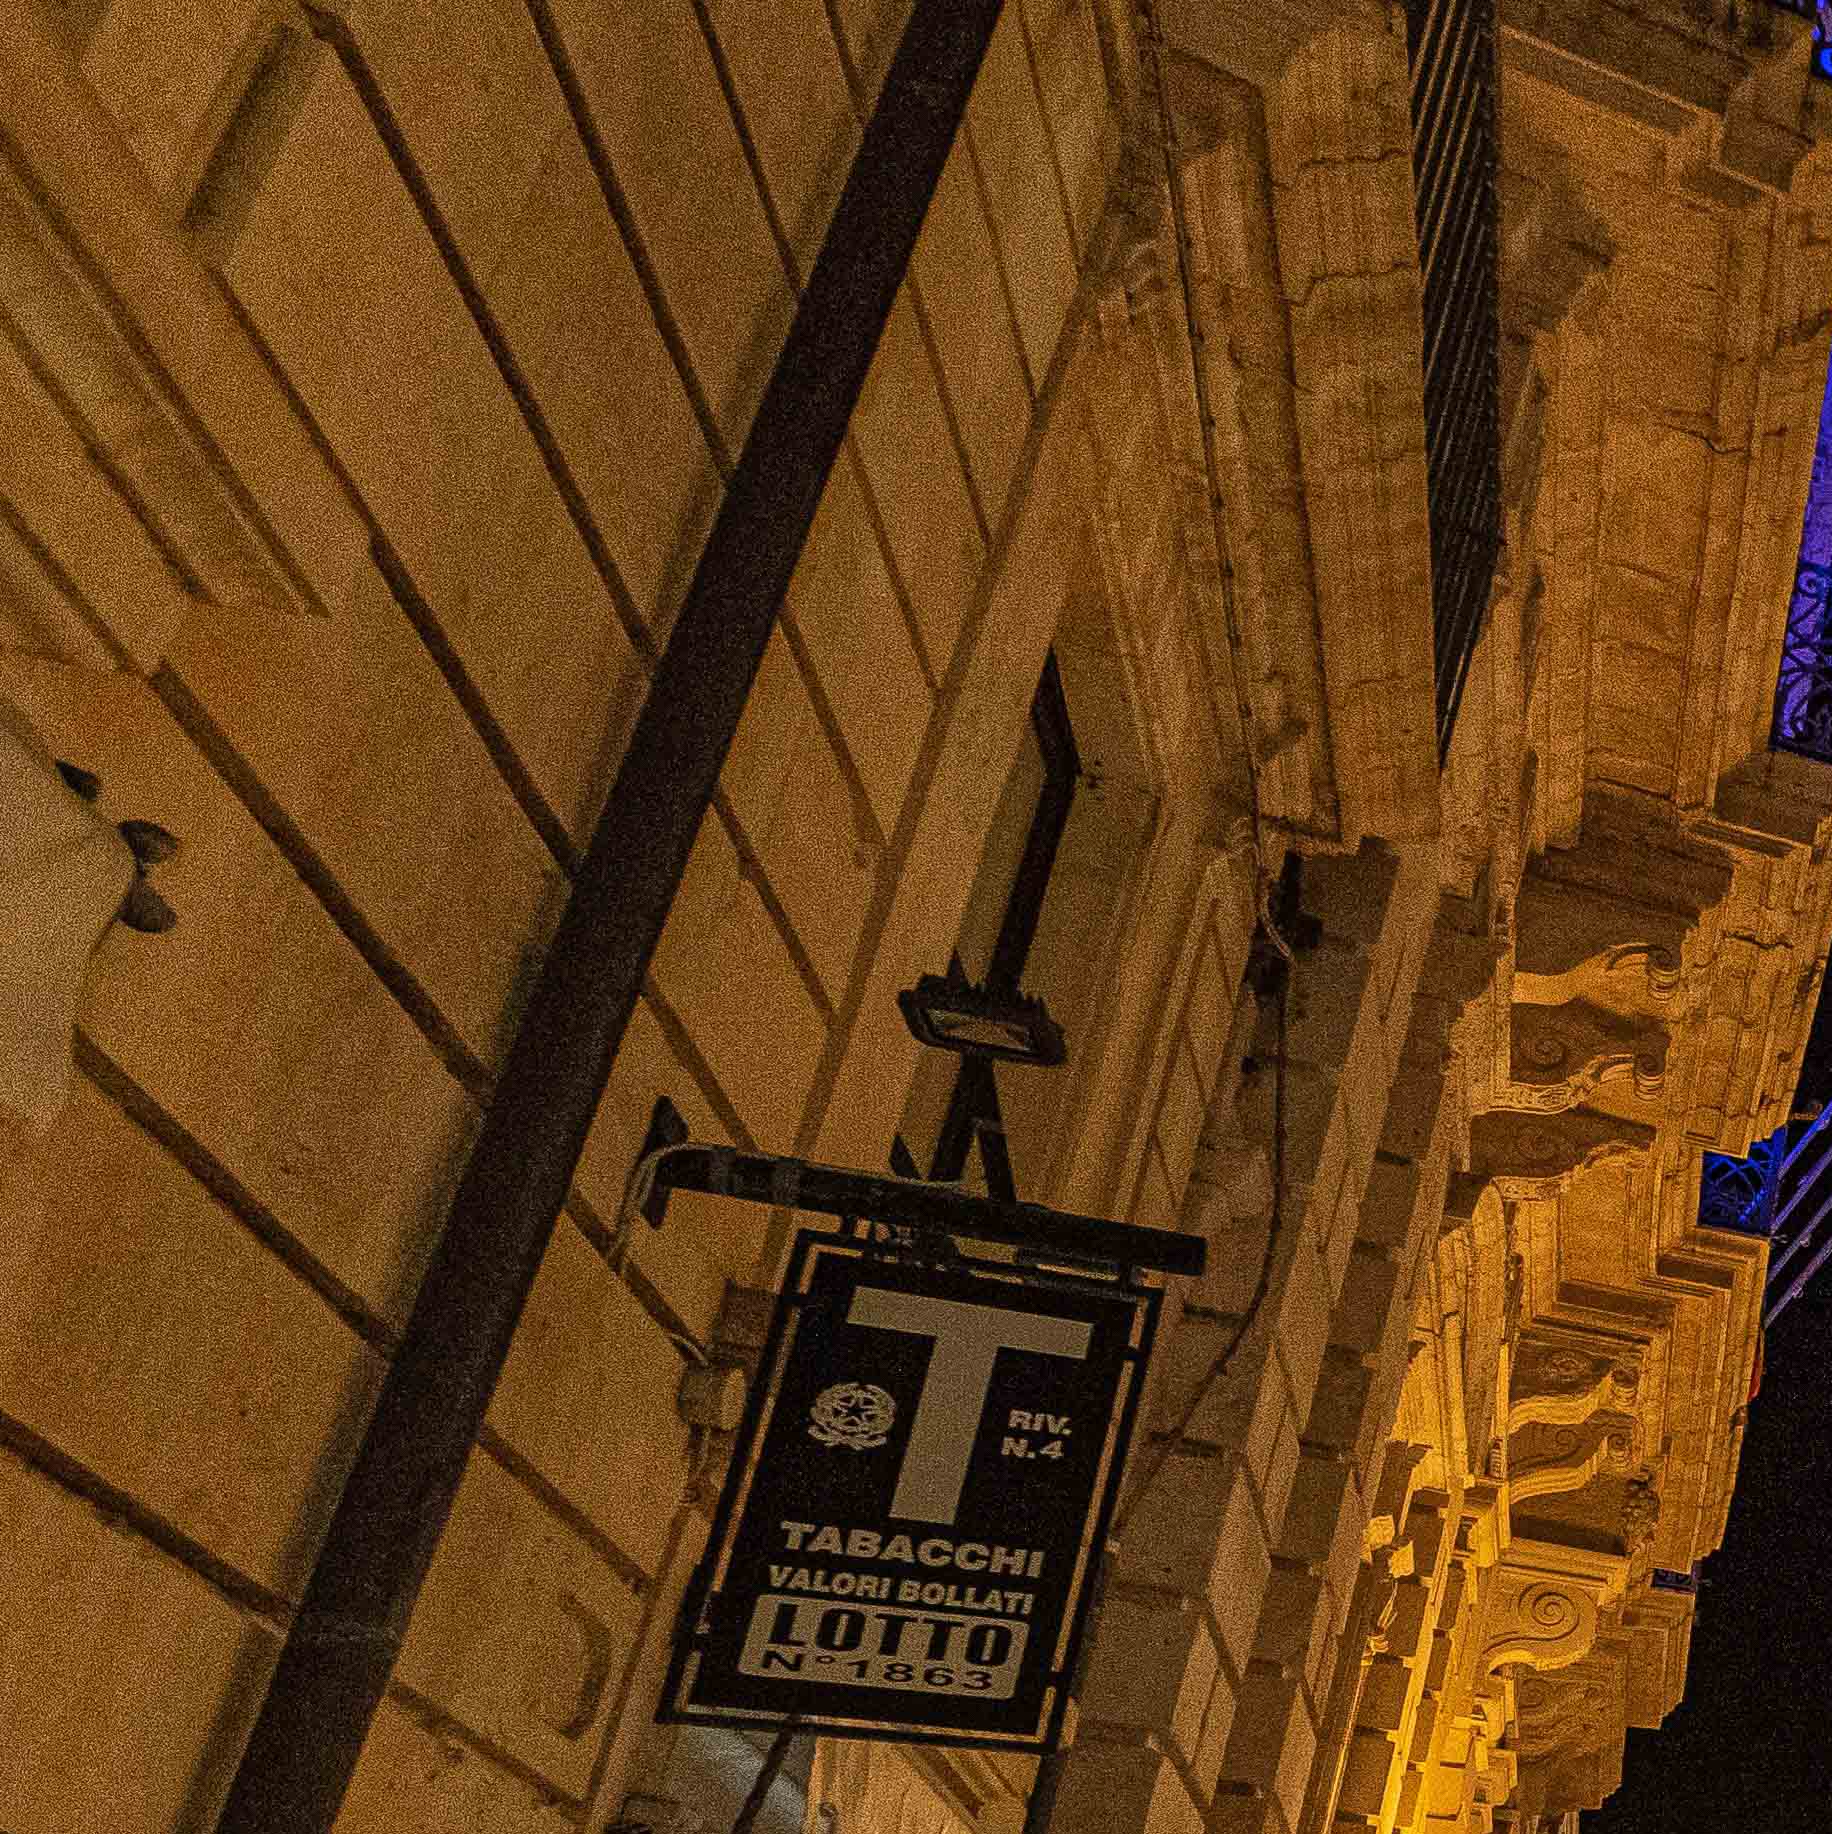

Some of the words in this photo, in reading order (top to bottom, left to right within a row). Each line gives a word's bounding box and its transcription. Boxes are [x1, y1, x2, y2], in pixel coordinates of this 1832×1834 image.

[847, 1285, 1093, 1526] T
[1008, 1408, 1072, 1436] RIV.
[780, 1520, 1045, 1578] TABACCHI
[768, 1564, 892, 1599] VALORI
[898, 1577, 1034, 1616] BOLLATI
[767, 1601, 1014, 1666] LOTTO
